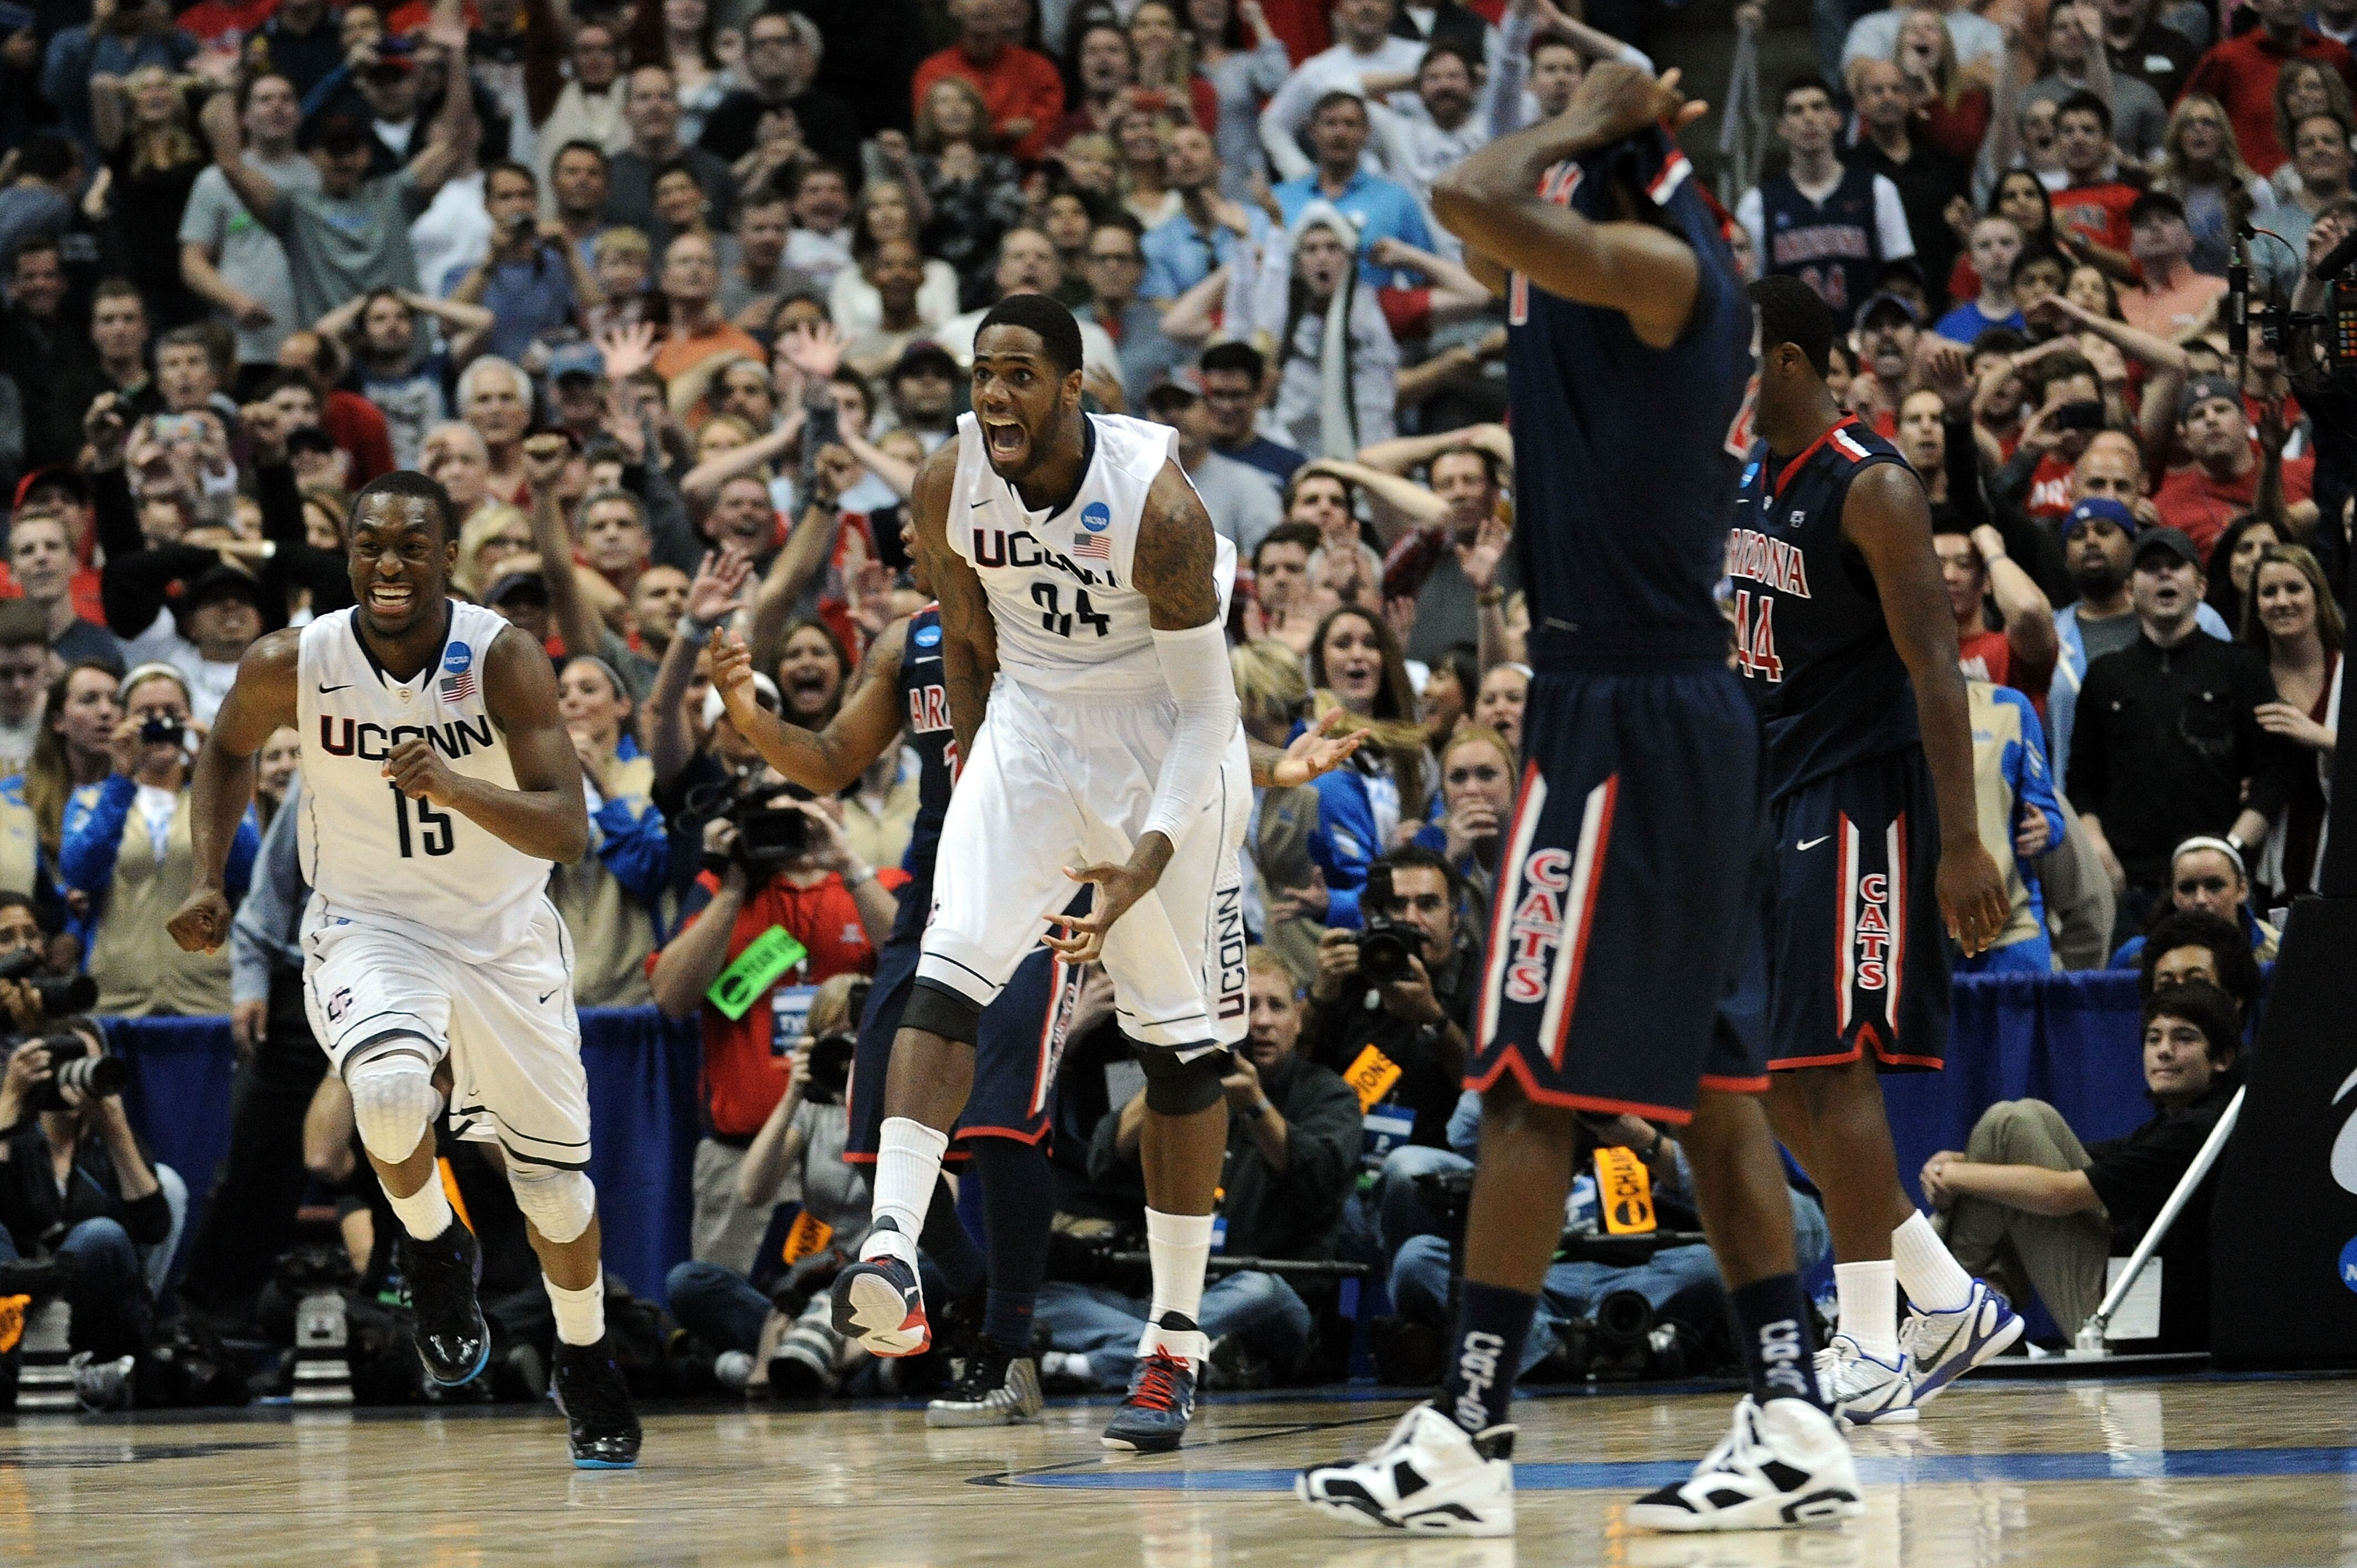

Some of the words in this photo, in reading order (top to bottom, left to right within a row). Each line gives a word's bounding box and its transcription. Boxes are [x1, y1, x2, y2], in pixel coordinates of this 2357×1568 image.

[1031, 582, 1109, 637] 24
[320, 714, 493, 761] UCONN
[388, 780, 454, 858] 15
[1217, 886, 1244, 1020] UCONN
[1504, 848, 1572, 1003] CATS
[1856, 874, 1890, 990] CATS
